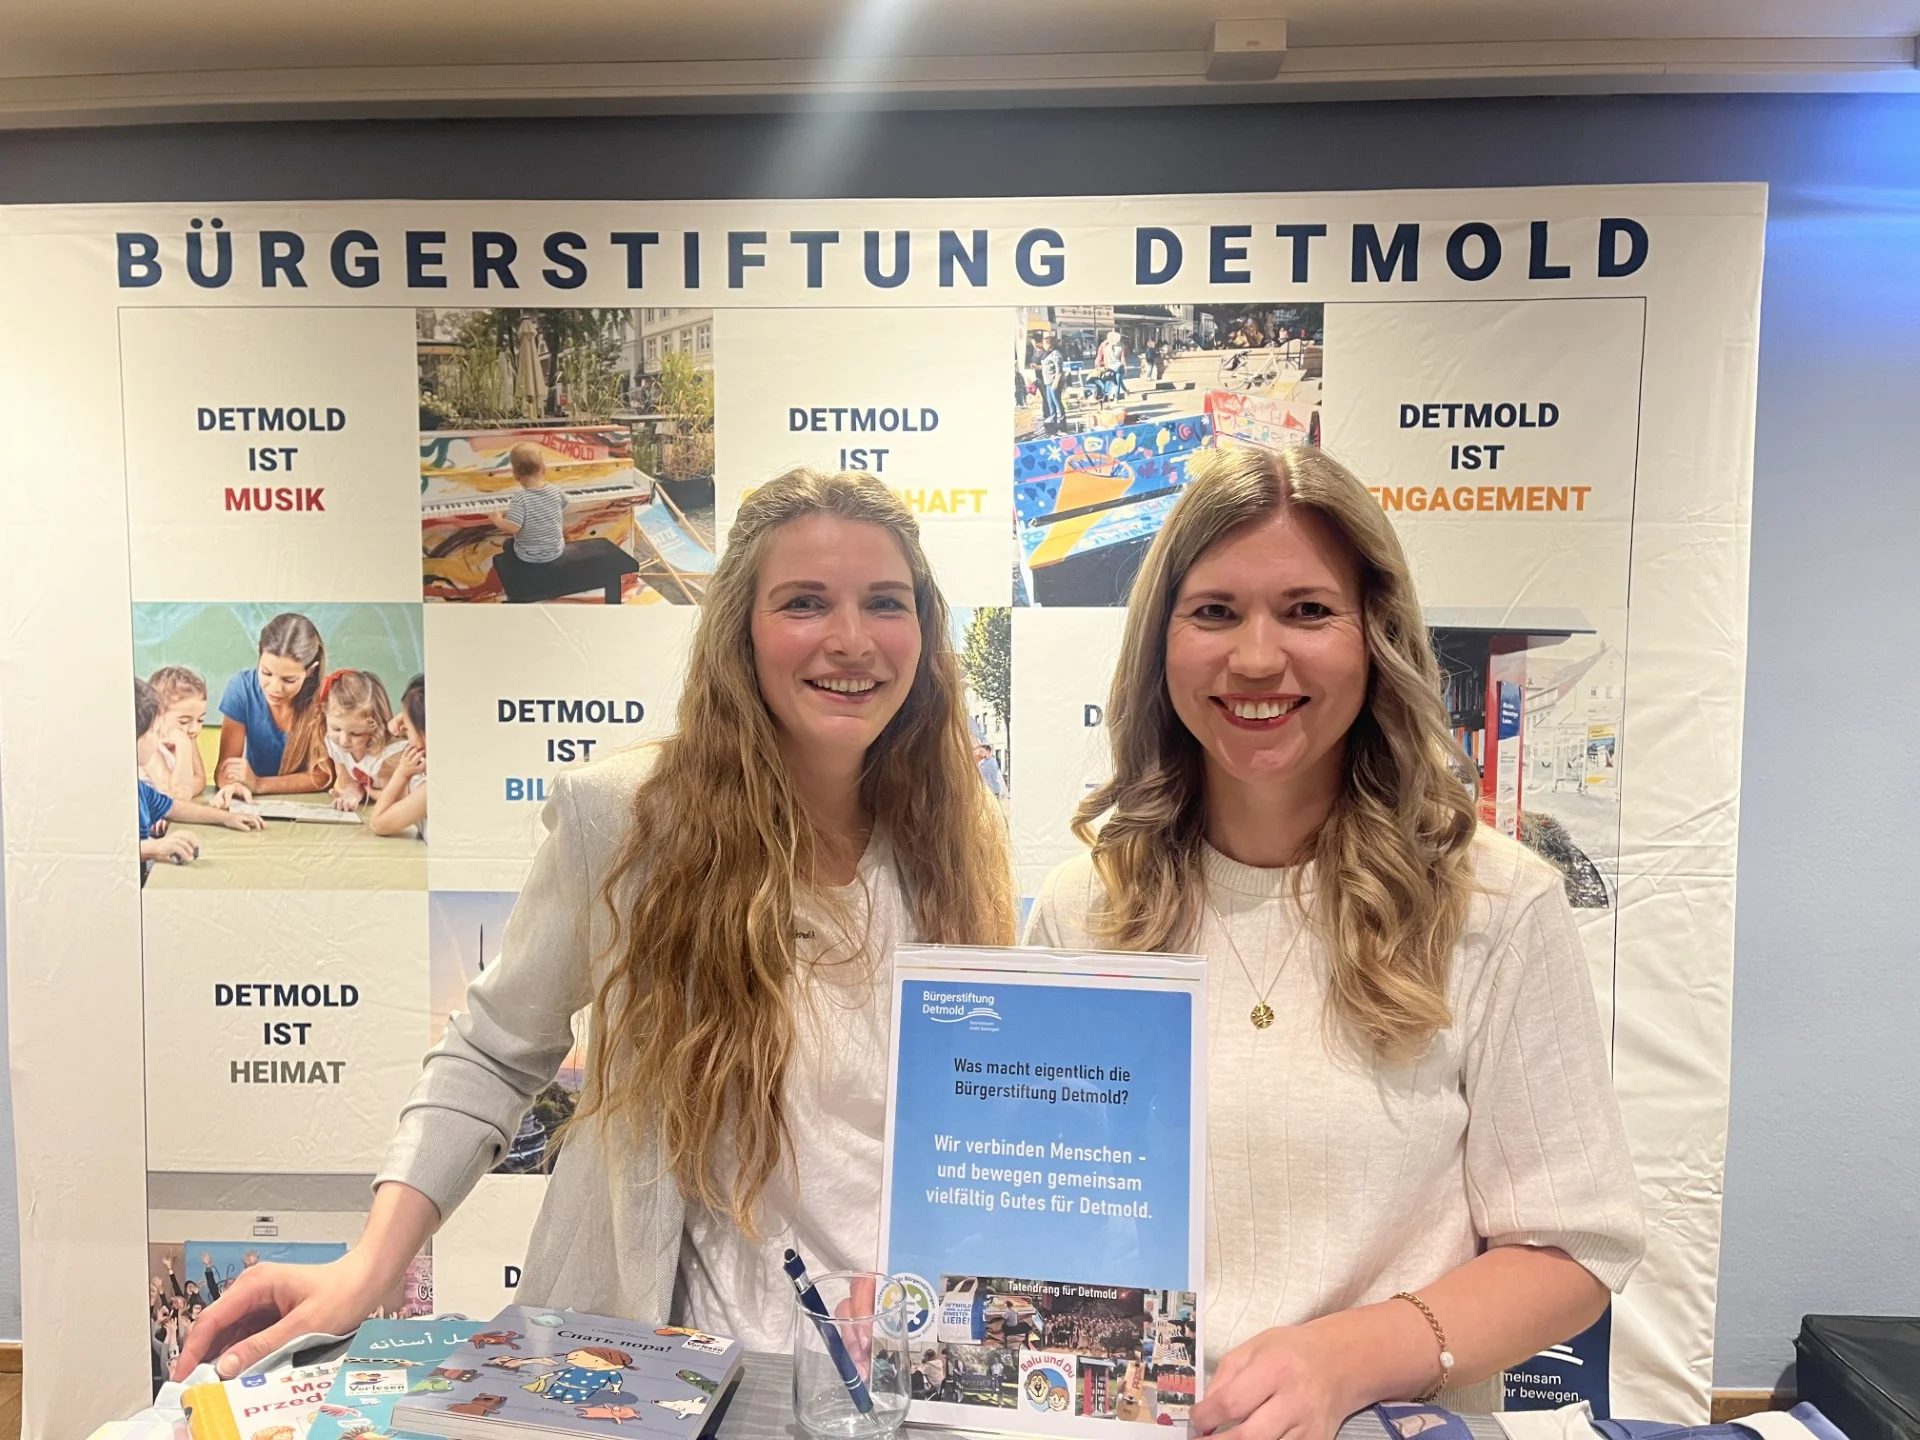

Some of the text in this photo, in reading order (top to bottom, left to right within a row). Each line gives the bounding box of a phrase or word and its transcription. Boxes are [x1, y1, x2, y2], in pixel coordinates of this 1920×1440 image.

[117, 217, 1651, 290] BÜRGERSTIFTUNG DETMOLD
[198, 407, 346, 432] DETMOLD
[789, 407, 939, 432] DETMOLD
[1400, 403, 1560, 430] DETMOLD
[541, 433, 595, 461] DETMOLD
[1451, 445, 1505, 470] IST
[248, 448, 298, 471] IST
[840, 448, 889, 472] IST
[224, 487, 326, 512] MUSIK
[498, 699, 645, 723] DETMOLD
[547, 739, 597, 762] IST
[215, 983, 359, 1007] DETMOLD
[923, 990, 995, 1006] Bürgerstiftung
[922, 1004, 964, 1016] Detmold
[264, 1022, 312, 1045] IST
[230, 1060, 346, 1084] HEIMAT
[954, 1058, 1131, 1082] Was macht eigentlich die
[955, 1081, 1129, 1105] Bürgerstiftung Detmold?
[934, 1135, 961, 1152] Wir
[966, 1139, 1045, 1158] verbinden
[1050, 1143, 1132, 1164] Menschen
[937, 1163, 1142, 1191] und bewegen gemeinsam
[926, 1187, 1153, 1219] vielfältig Gutes für Detmold.
[1008, 1281, 1117, 1300] Tatendrang für Detmold
[942, 1316, 970, 1325] LIEBE!
[557, 1330, 614, 1345] Спать
[620, 1340, 672, 1353] пора!
[1020, 1355, 1075, 1379] Balu und Du
[1503, 1372, 1561, 1385] meinsam
[290, 1380, 333, 1394] Mo
[348, 1384, 405, 1392] Vorlesen
[1503, 1386, 1583, 1403] hr bewegen.
[243, 1392, 323, 1417] przed
